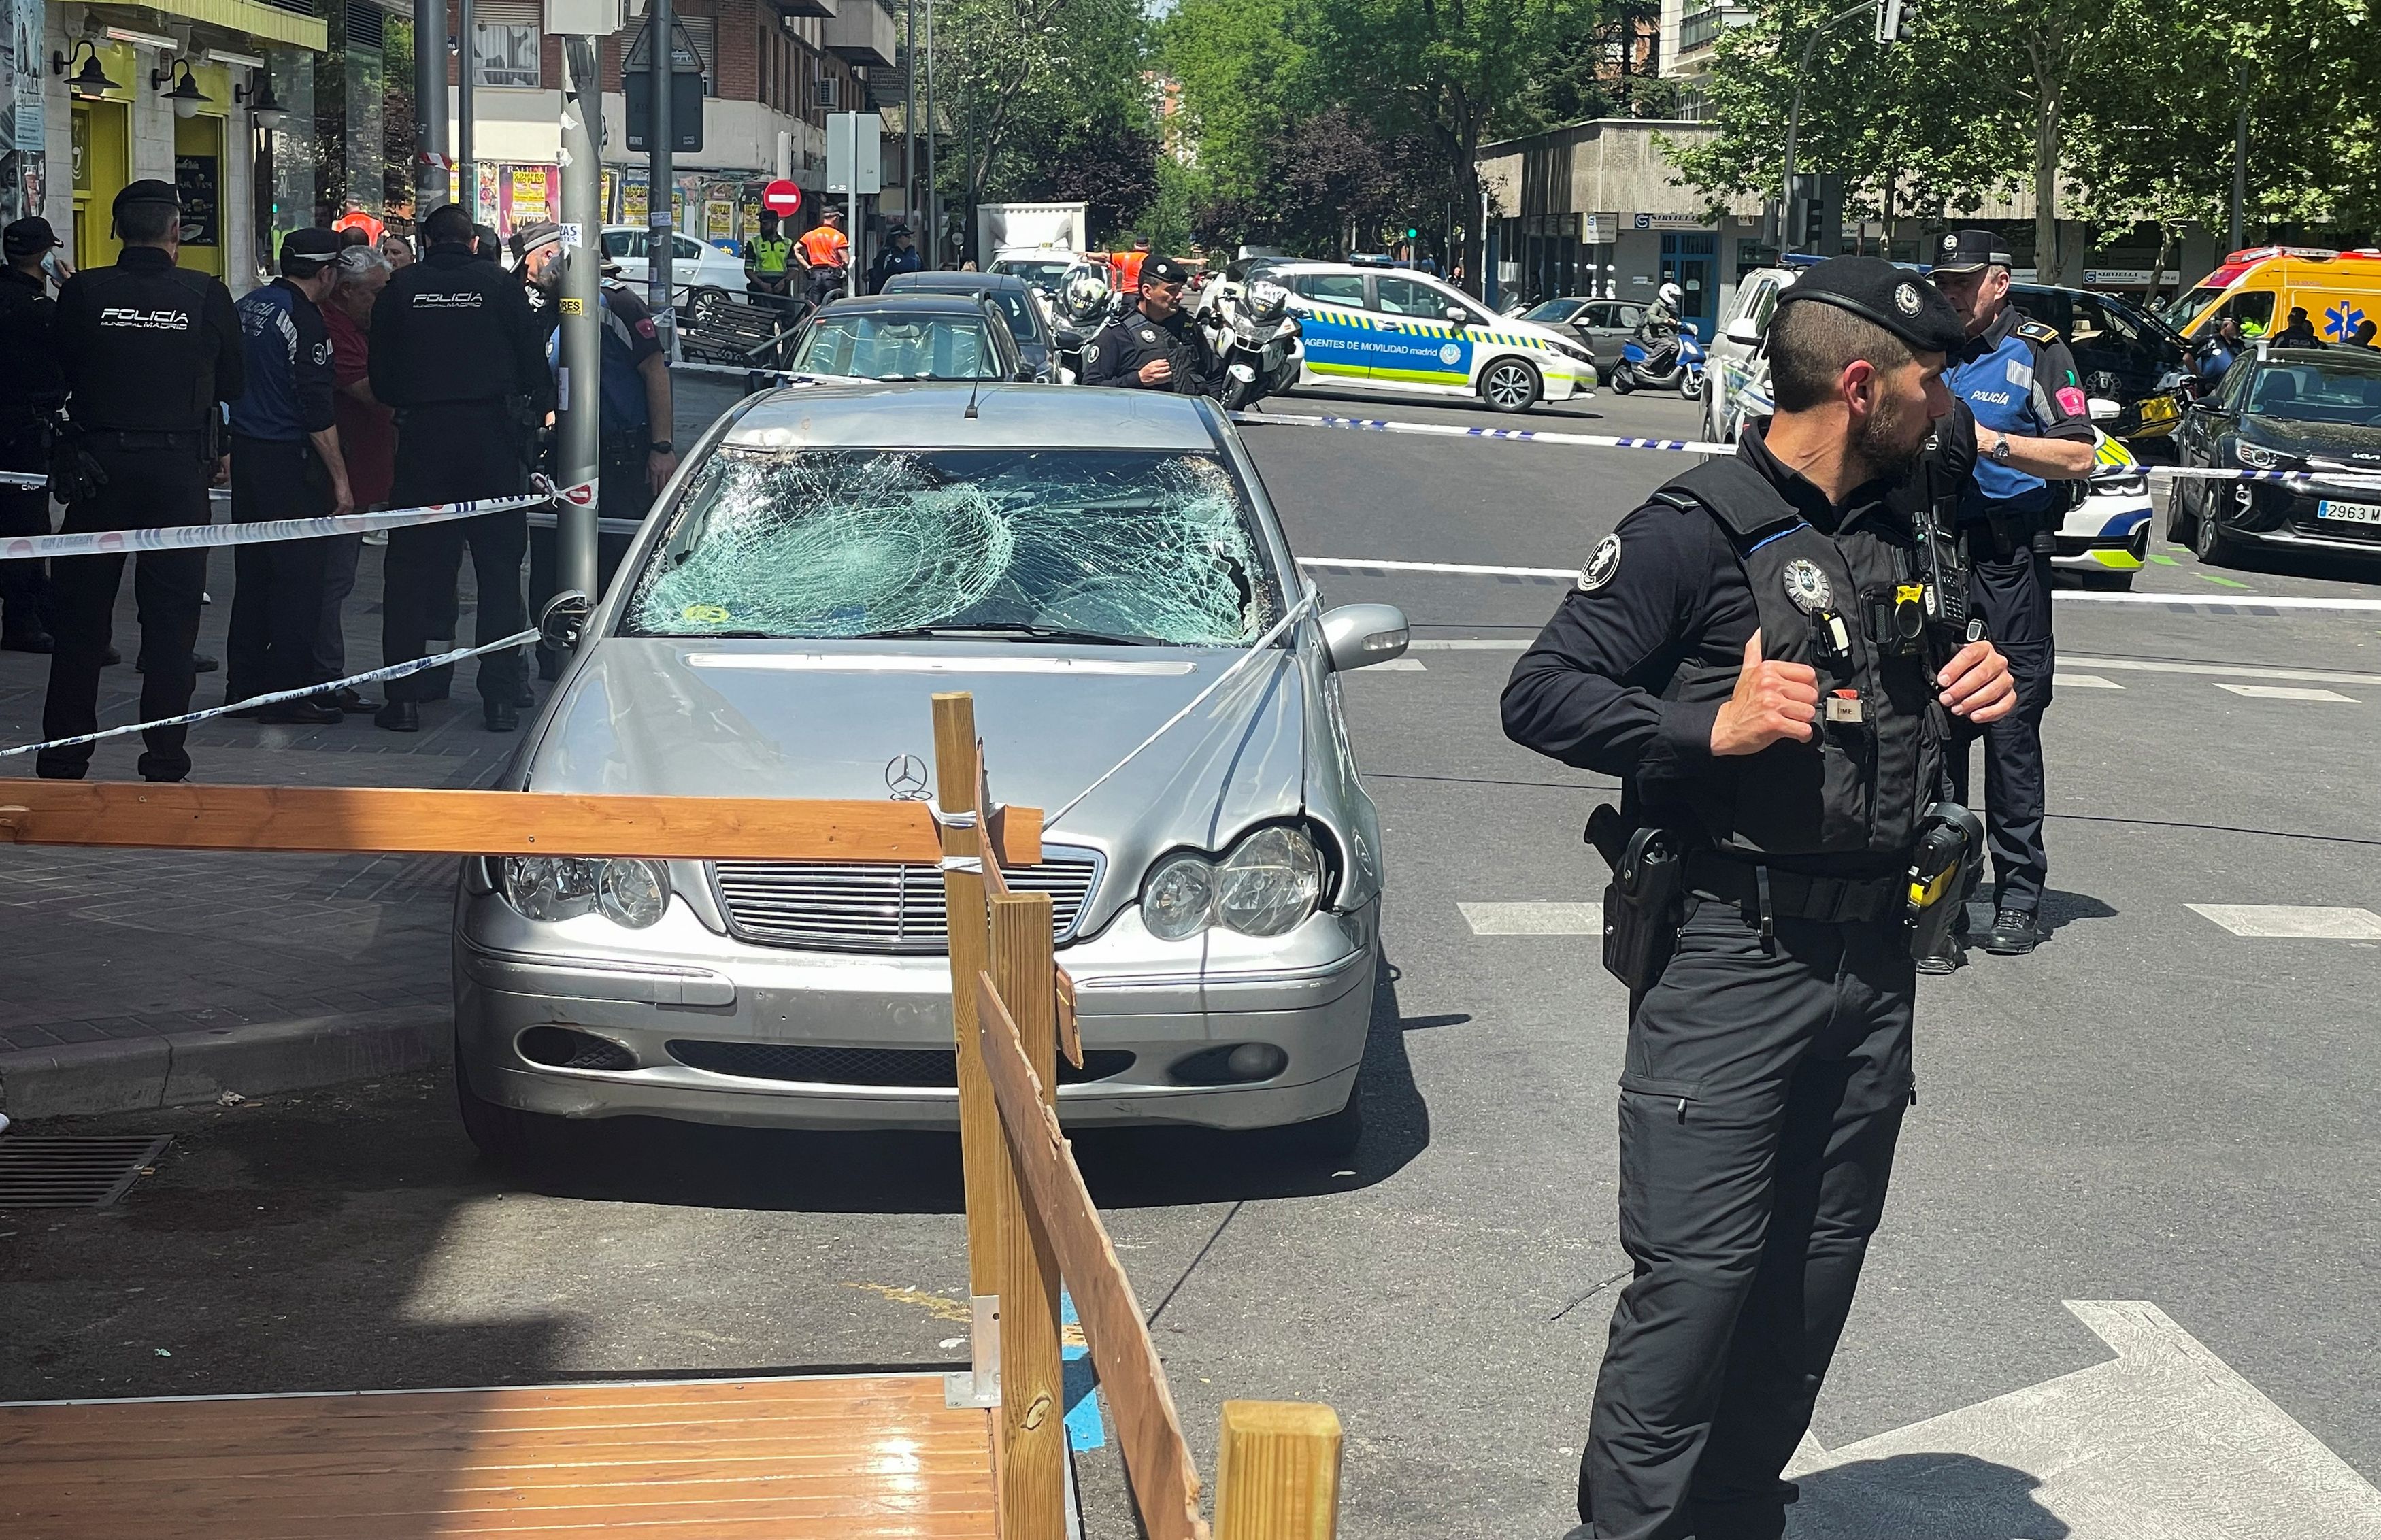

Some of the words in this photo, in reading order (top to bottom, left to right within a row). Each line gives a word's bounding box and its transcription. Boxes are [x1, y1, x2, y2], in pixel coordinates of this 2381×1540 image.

[413, 290, 483, 303] POLICÍA
[101, 308, 189, 324] POLICÍA
[143, 322, 188, 330] MADRID
[1304, 337, 1346, 349] AGENTES
[1346, 341, 1360, 350] DE
[1361, 342, 1408, 354] MOVILIDAD
[1409, 348, 1438, 357] madrid
[1970, 390, 2010, 405] POLICÍA
[2327, 505, 2366, 520] 2963
